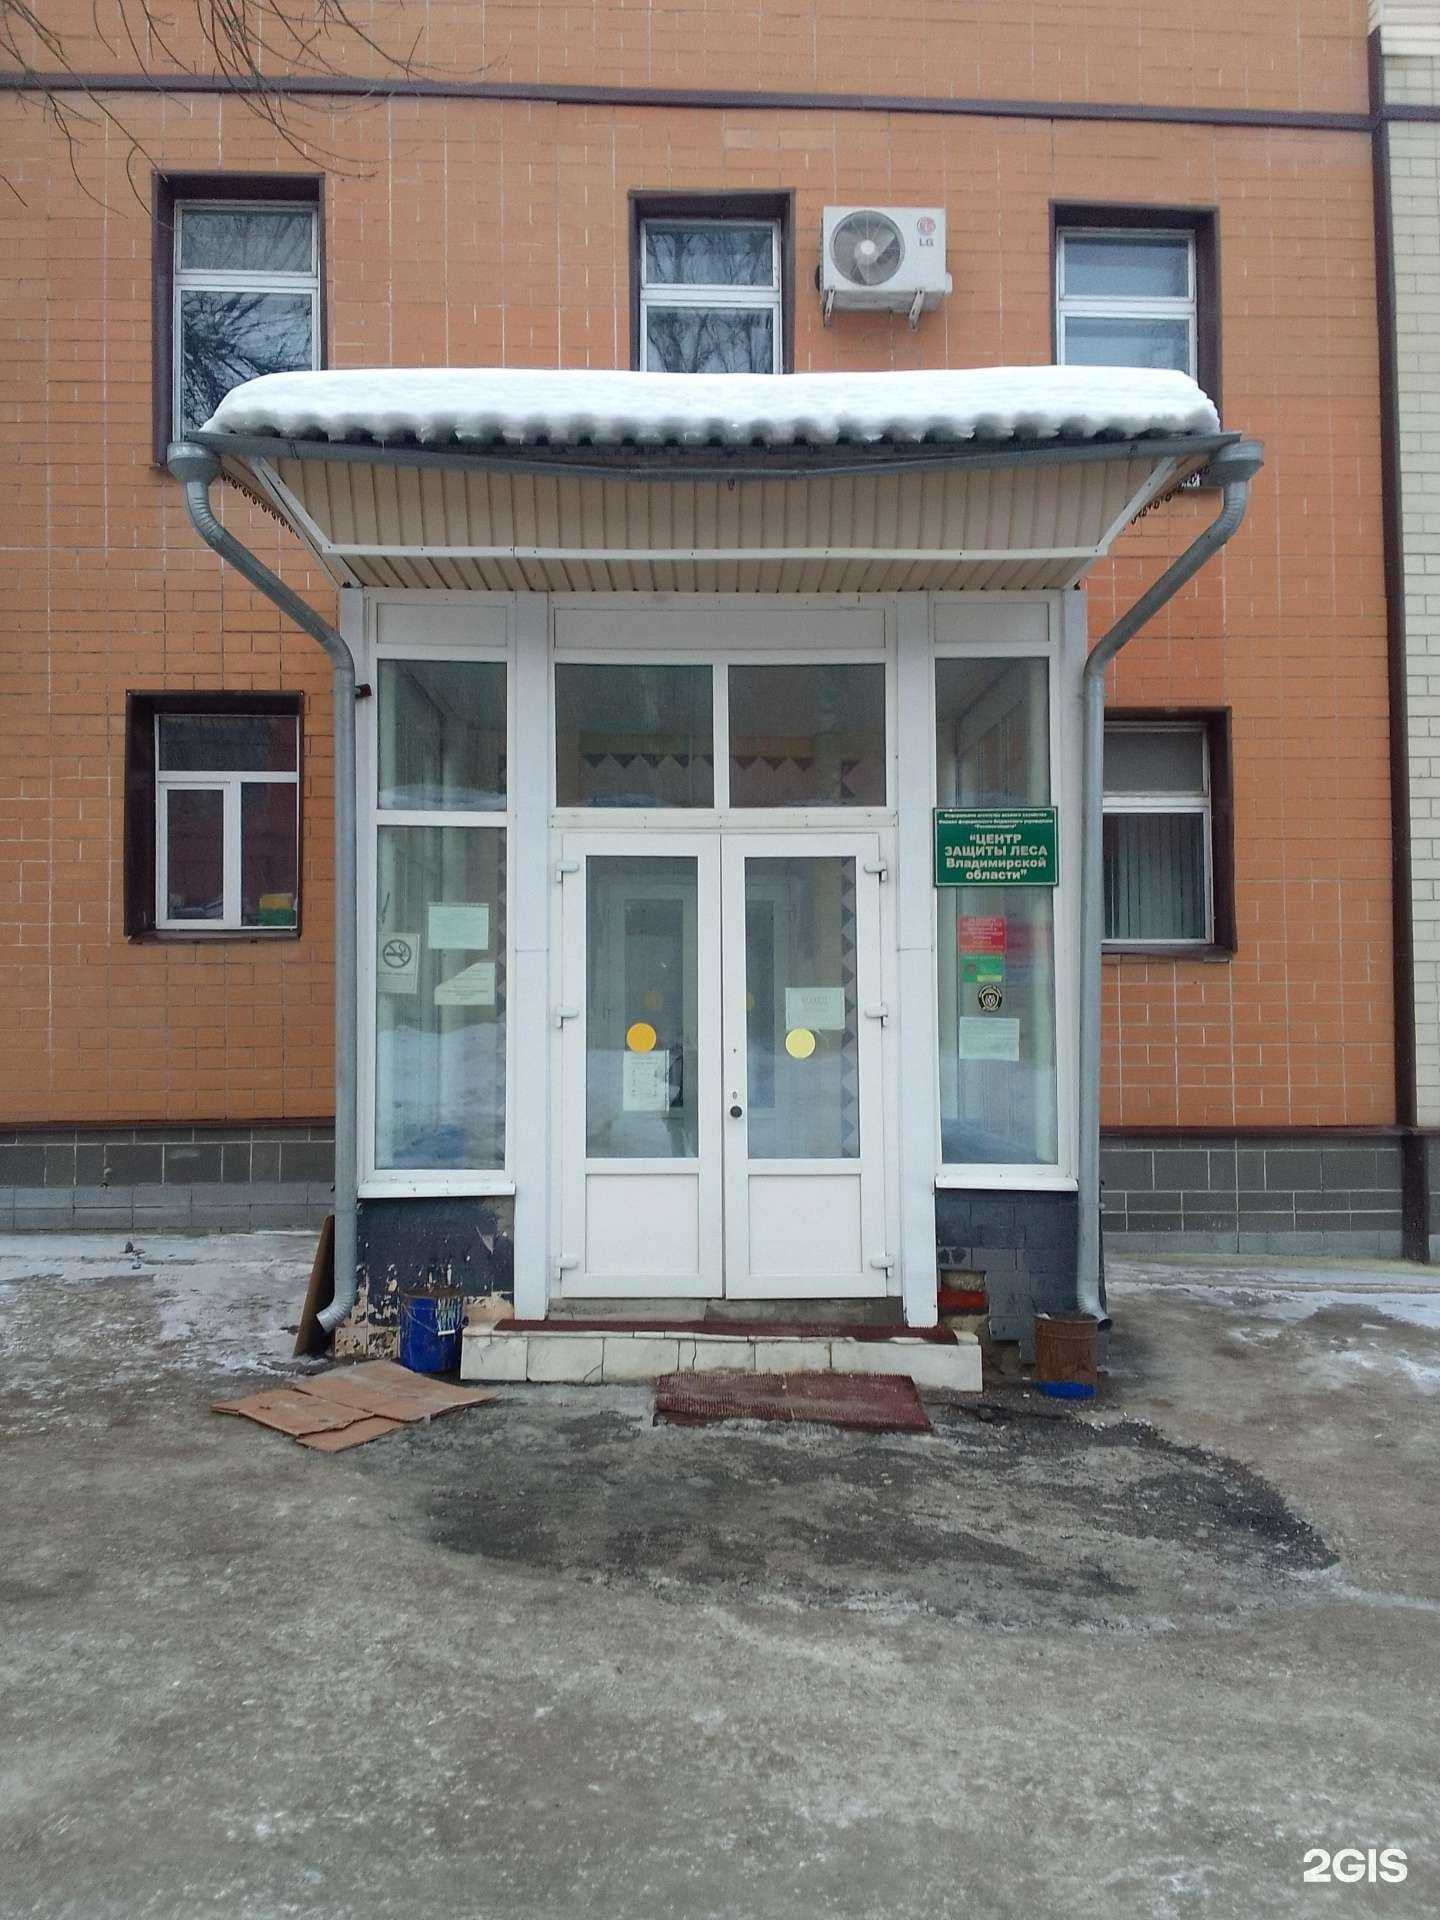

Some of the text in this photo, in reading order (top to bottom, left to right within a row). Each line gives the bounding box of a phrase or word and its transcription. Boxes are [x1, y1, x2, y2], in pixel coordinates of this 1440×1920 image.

[919, 237, 934, 247] LG
[944, 846, 1048, 858] ЗАЩИТЫ ЛЕСА
[946, 857, 1047, 870] Владимирской
